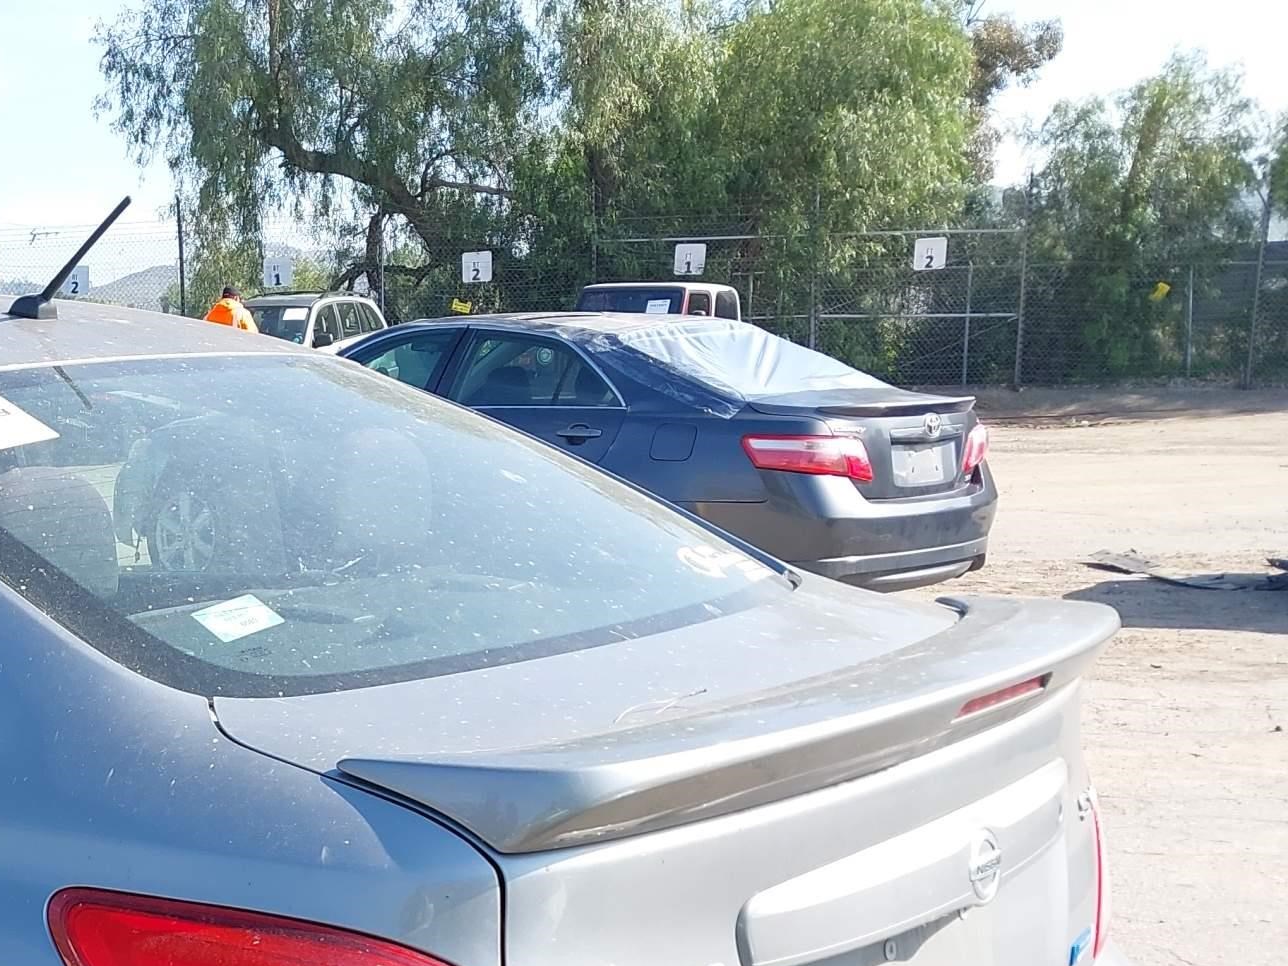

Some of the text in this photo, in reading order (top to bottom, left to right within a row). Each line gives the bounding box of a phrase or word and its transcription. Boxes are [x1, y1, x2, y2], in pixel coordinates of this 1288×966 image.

[684, 261, 693, 274] 1
[924, 255, 934, 269] 2
[274, 273, 283, 286] 1
[471, 268, 481, 281] 2
[70, 281, 80, 294] 2
